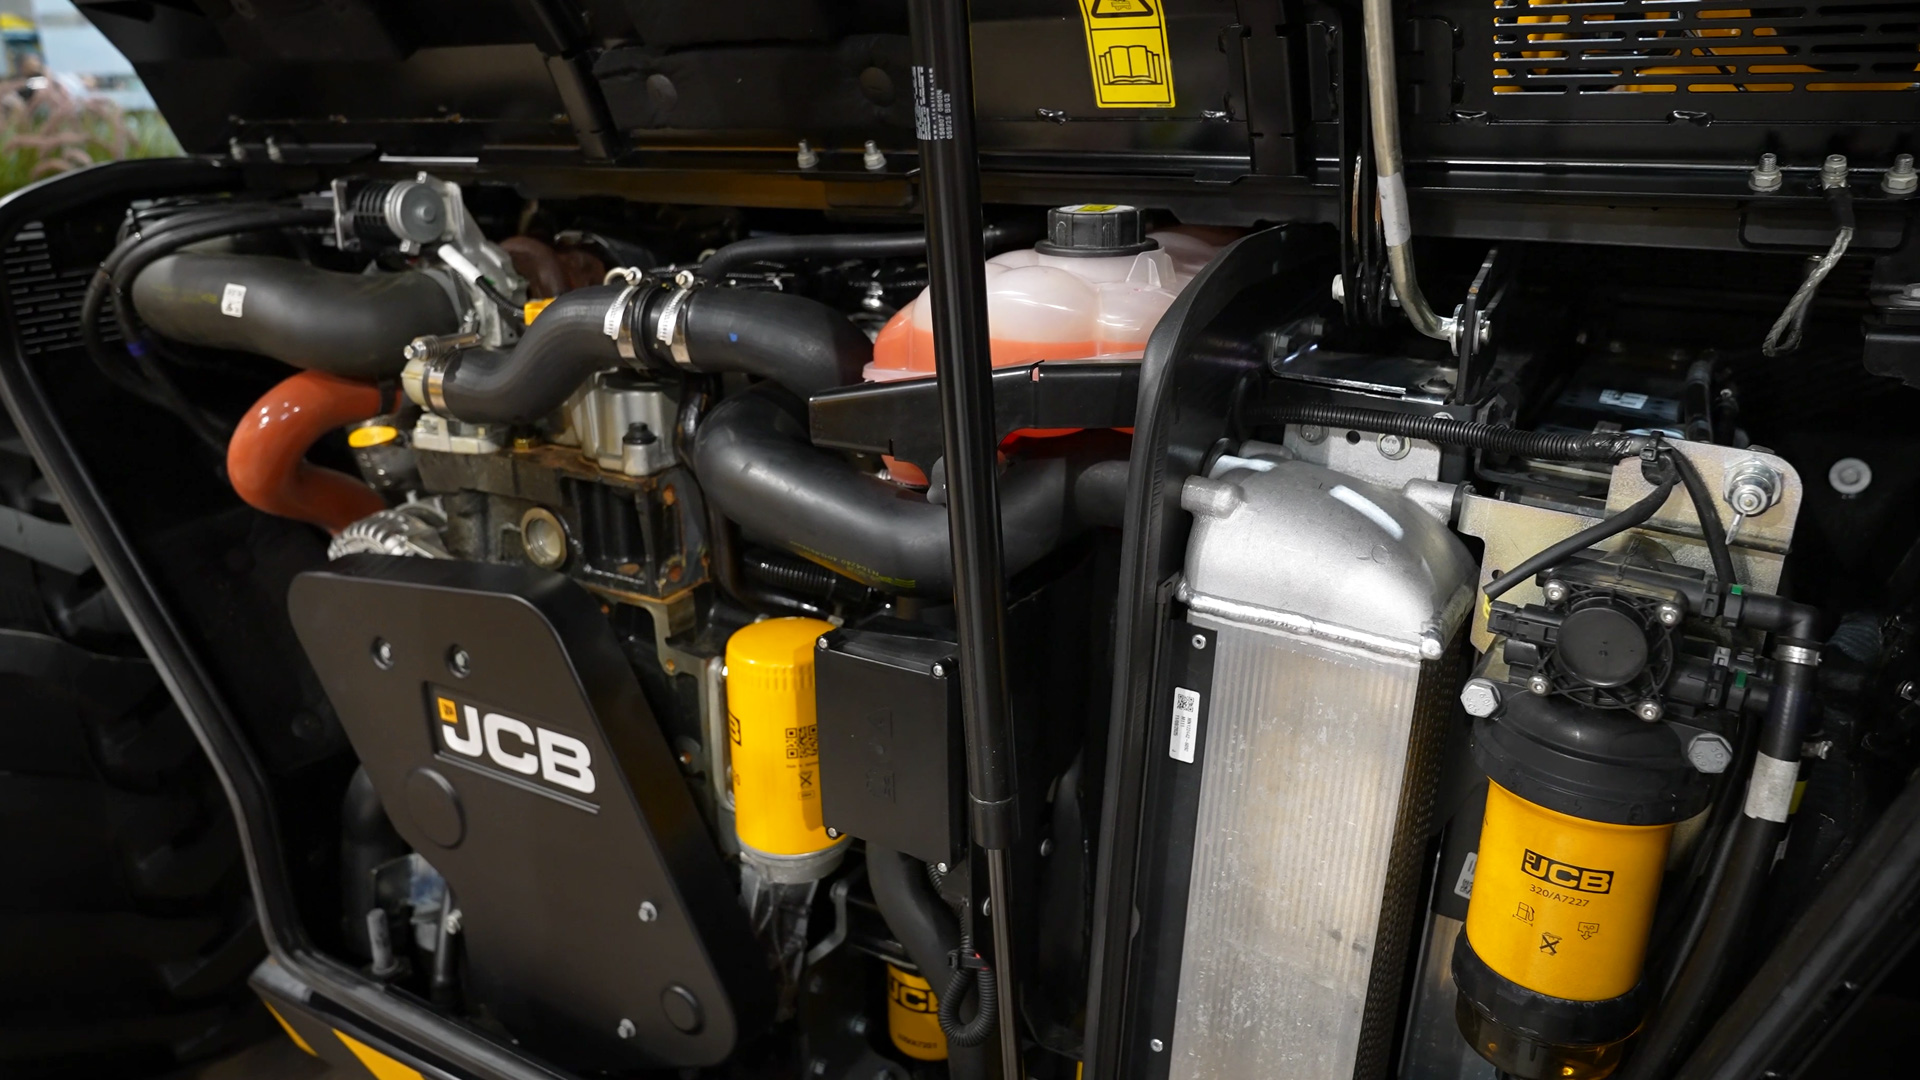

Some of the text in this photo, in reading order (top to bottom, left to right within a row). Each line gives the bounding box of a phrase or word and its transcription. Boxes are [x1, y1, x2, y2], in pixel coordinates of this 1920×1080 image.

[438, 697, 595, 793] JCB
[1523, 850, 1612, 893] JCB
[1529, 883, 1590, 907] 320/A7227
